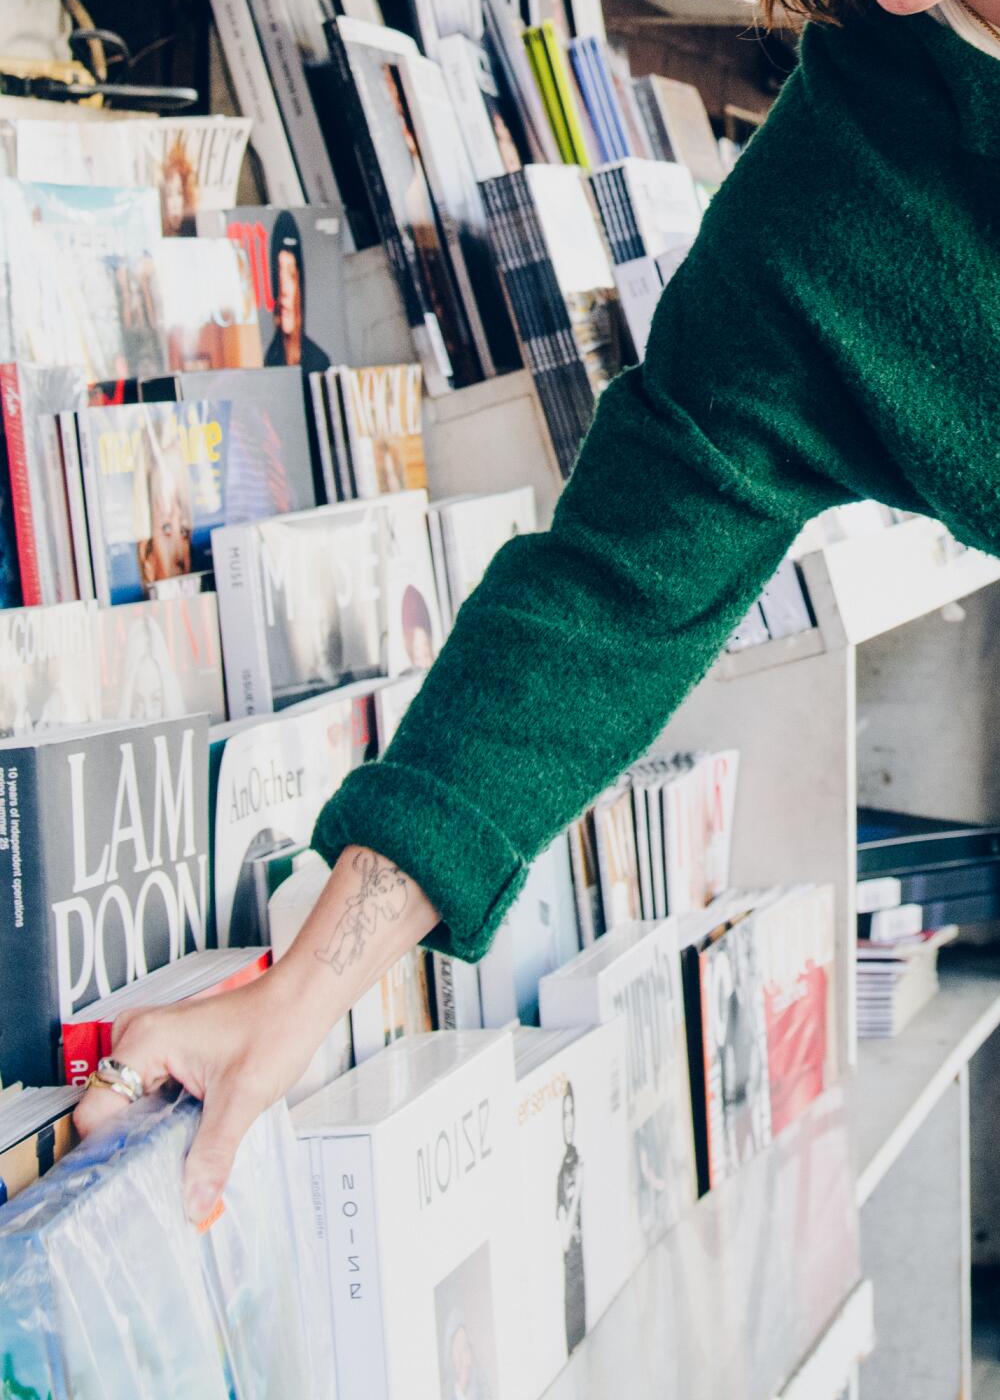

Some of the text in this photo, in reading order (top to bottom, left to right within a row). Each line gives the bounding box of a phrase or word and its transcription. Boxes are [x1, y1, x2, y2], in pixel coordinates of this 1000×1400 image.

[229, 546, 242, 589] MUSE
[7, 766, 24, 928] 10 years of independent operations
[68, 728, 197, 893] LAM
[52, 854, 207, 1024] POON
